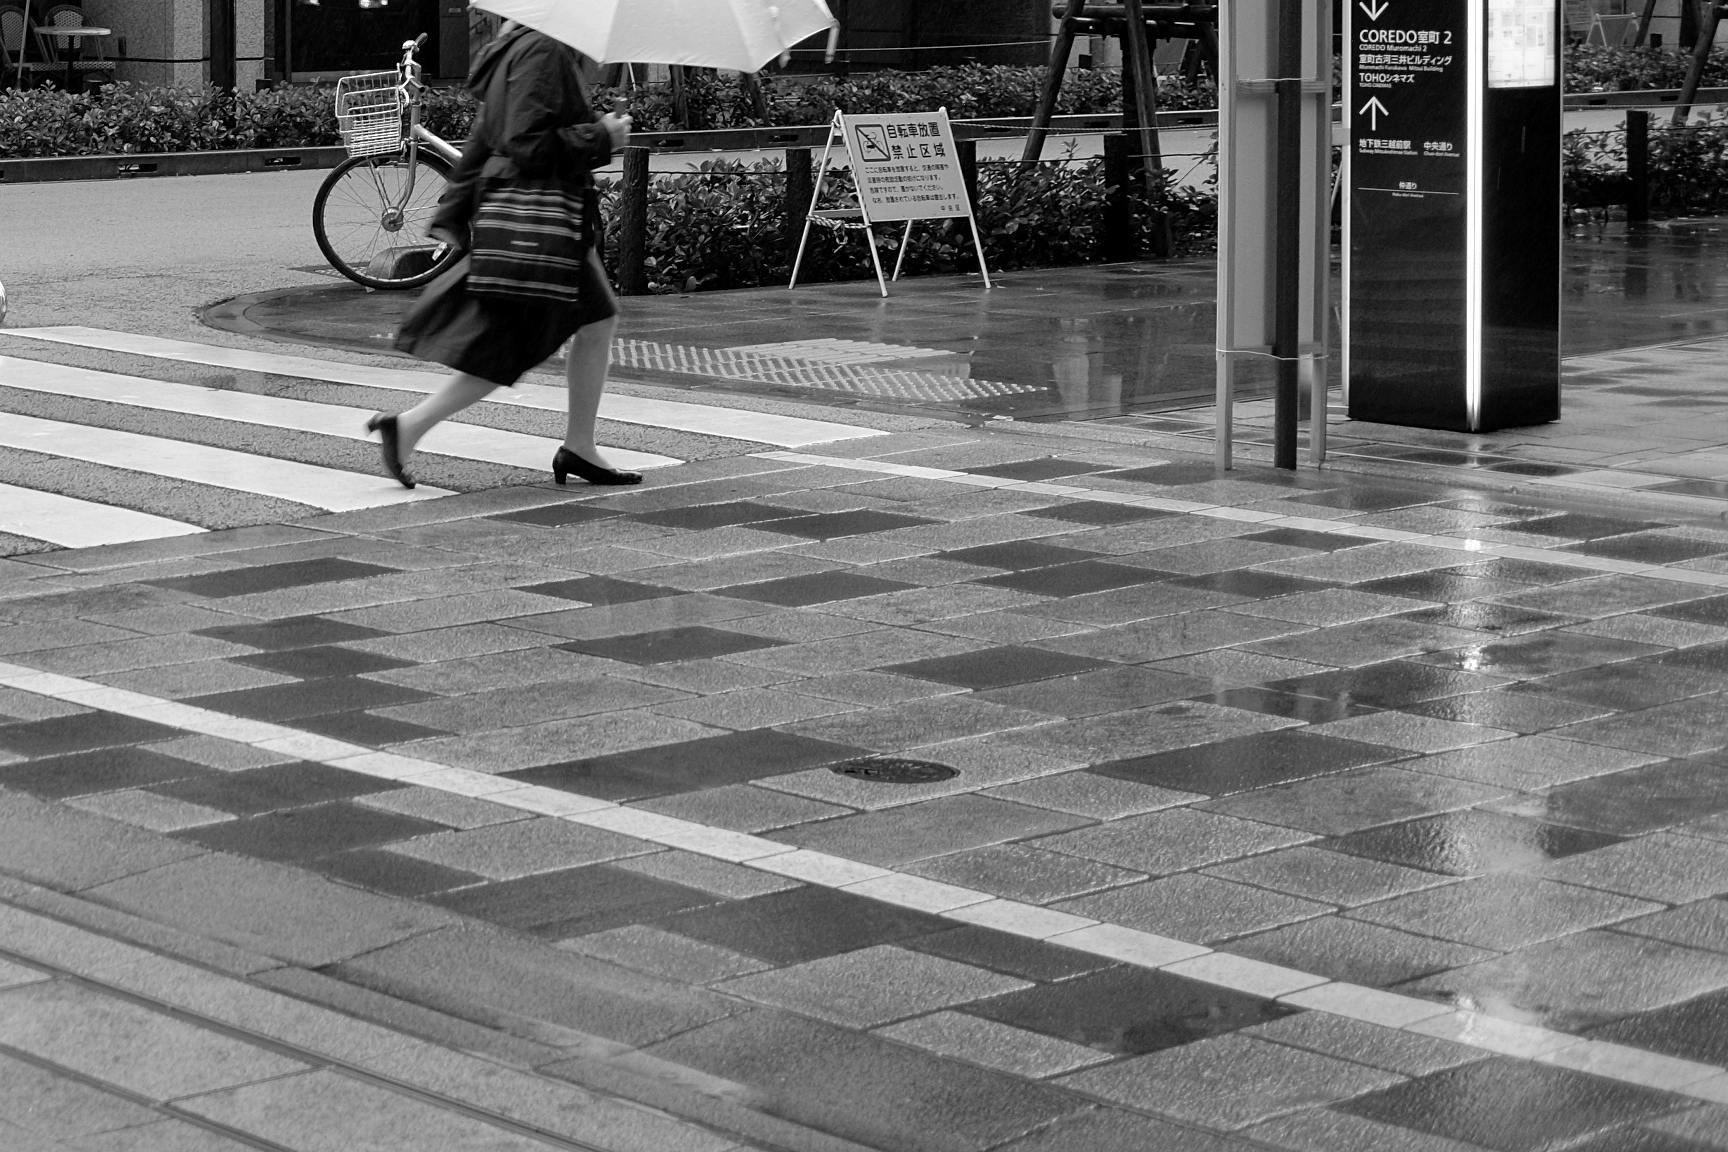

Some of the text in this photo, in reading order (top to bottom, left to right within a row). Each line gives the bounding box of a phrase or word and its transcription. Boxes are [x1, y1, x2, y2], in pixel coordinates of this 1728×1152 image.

[1444, 31, 1452, 44] 2
[1359, 54, 1452, 66] 室町古河三井ビルディング
[1359, 73, 1414, 83] TOHOシネマズ
[887, 122, 940, 138] 自転車放置
[1360, 139, 1411, 149] 地下鉄三越前駅
[1424, 141, 1452, 151] 中央通り
[892, 143, 946, 160] 禁止区域
